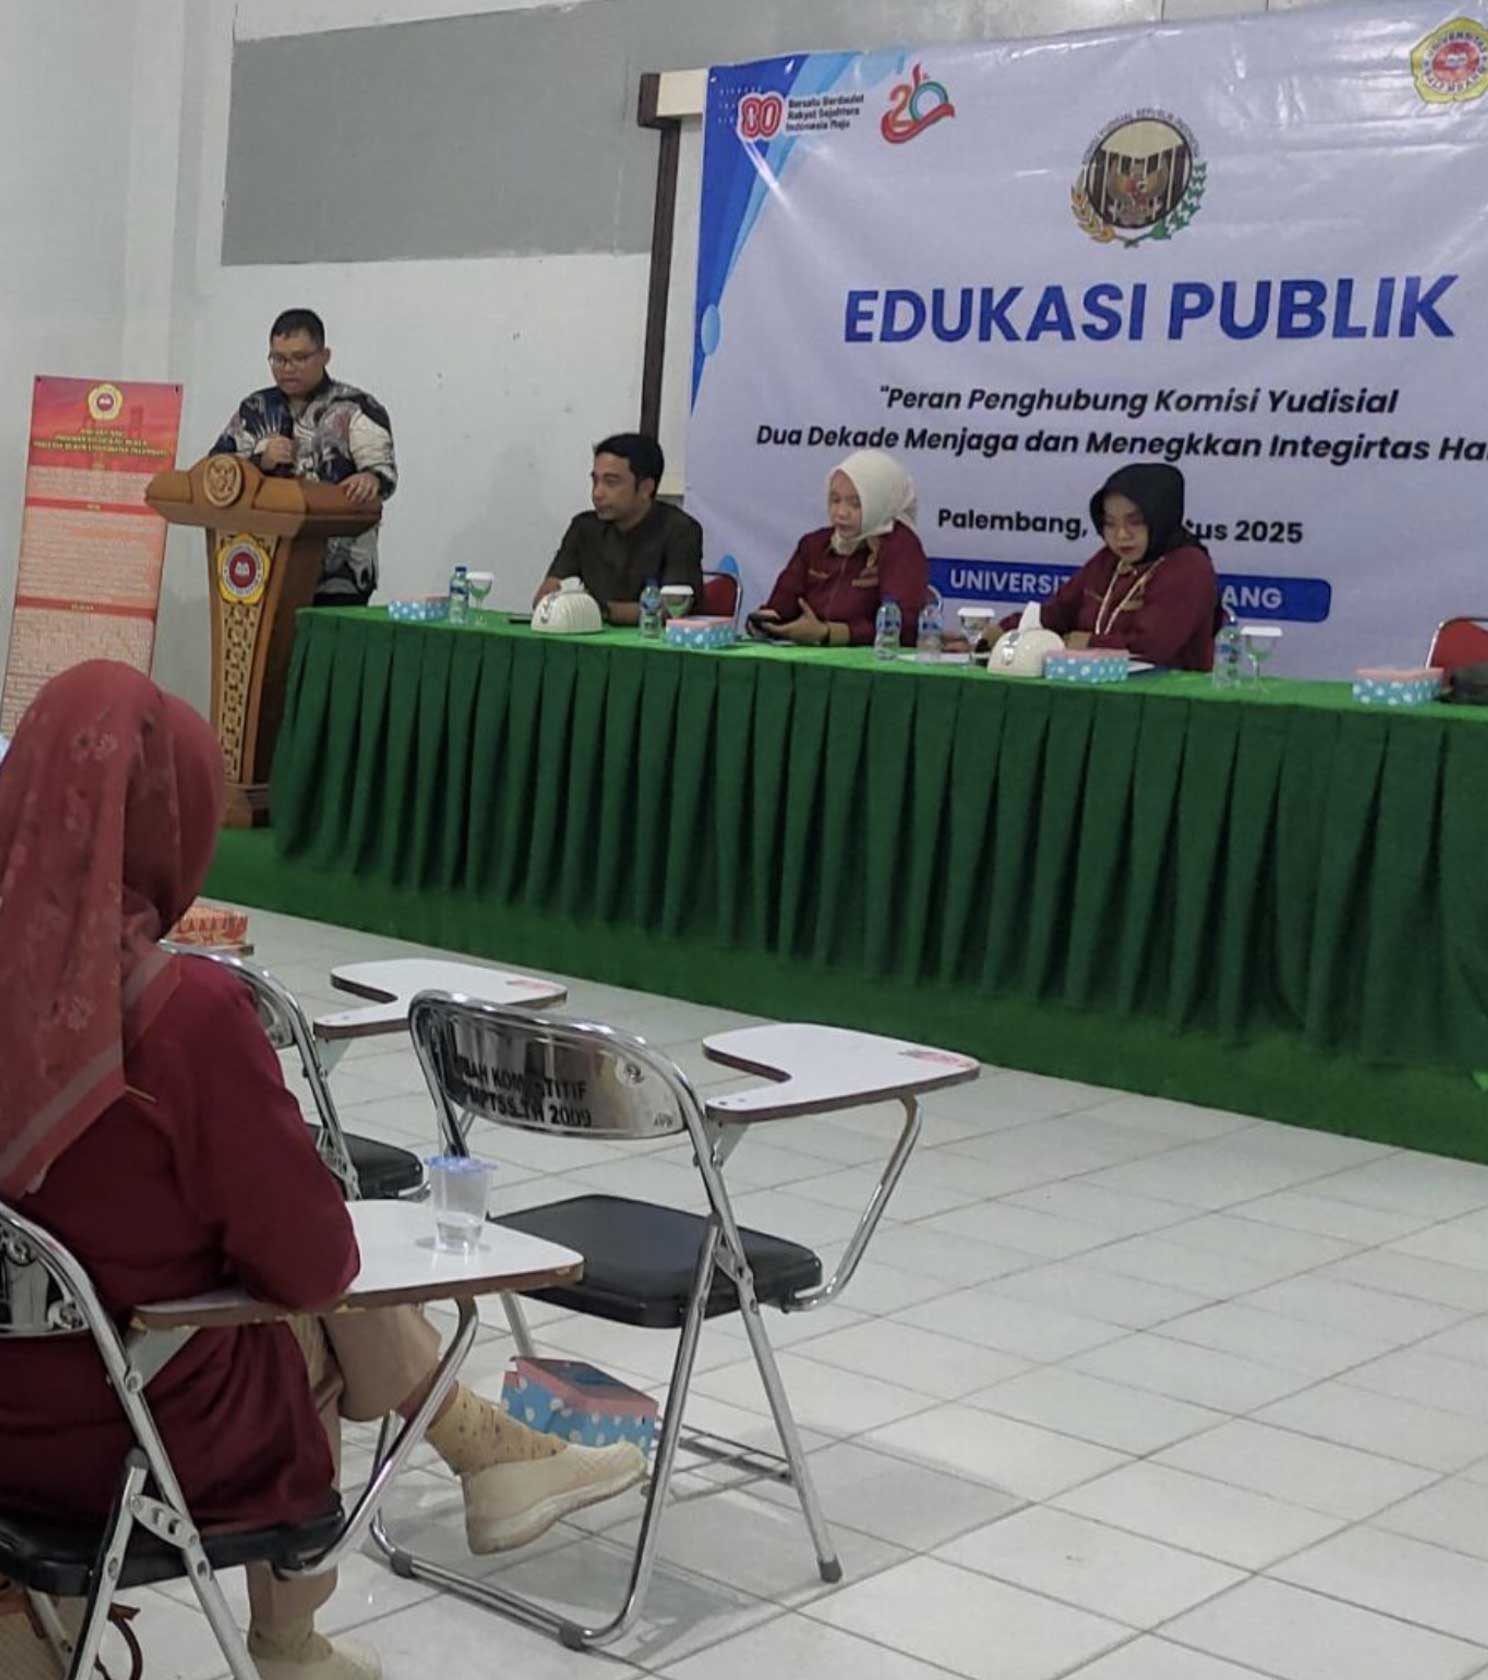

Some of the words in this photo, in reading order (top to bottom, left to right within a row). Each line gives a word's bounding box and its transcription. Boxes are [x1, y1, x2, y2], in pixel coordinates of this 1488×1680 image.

[844, 283, 1147, 343] EDUKASI
[1167, 275, 1459, 341] PUBLIK
[880, 386, 963, 410] "Peran
[968, 388, 1148, 419] Penghubung
[1154, 388, 1262, 413] Komisi
[1268, 388, 1400, 414] Yudisial
[756, 425, 803, 446] Dua
[807, 425, 900, 449] Dekade
[904, 427, 1018, 459] Menjaga
[1025, 430, 1079, 453] dan
[1085, 431, 1262, 463] Menegkkan
[1268, 433, 1431, 467] Integirtas
[1438, 437, 1488, 461] Ha
[937, 508, 1089, 541] Palembang,
[1233, 519, 1304, 544] 2025
[549, 1103, 592, 1128] 2009
